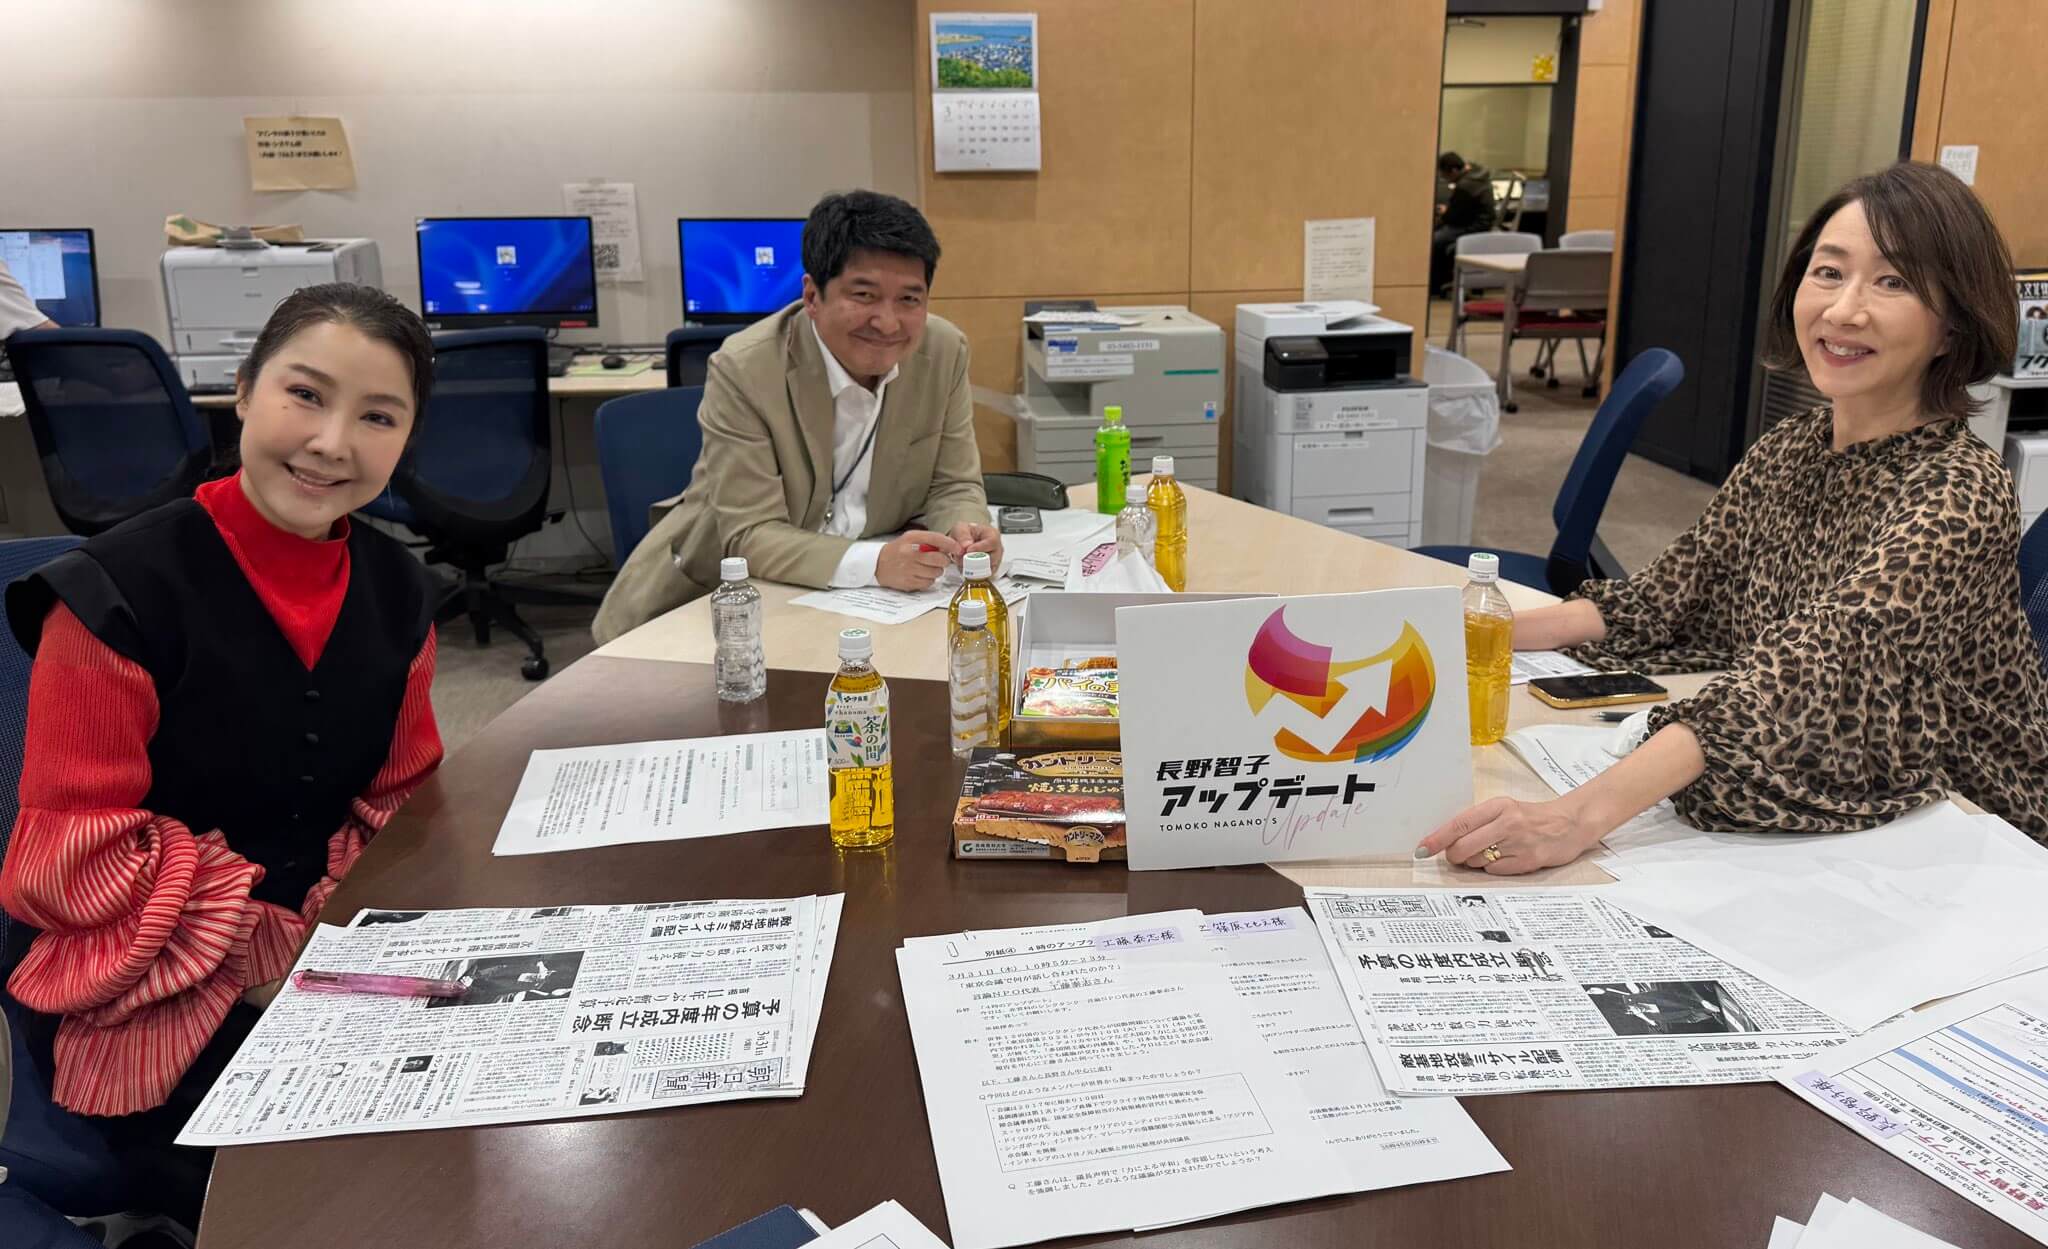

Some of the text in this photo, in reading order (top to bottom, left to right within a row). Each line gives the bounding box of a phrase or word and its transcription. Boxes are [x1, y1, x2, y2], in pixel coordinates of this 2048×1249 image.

[861, 715, 881, 762] 茶の間
[1156, 755, 1271, 781] 長野智子
[1160, 774, 1377, 816] アップデート
[1159, 821, 1209, 832] TOMOKO
[1262, 790, 1369, 850] Update
[1335, 899, 1426, 915] 朝日新聞
[651, 914, 794, 938] 敵基地攻撃ミサイル配備
[1100, 930, 1176, 948] 工藤泰志様
[1358, 952, 1512, 970] 予算の年度内成立
[572, 998, 782, 1033] 予算の年度内成立 断念
[1398, 1048, 1566, 1069] 敵基地攻撃ミサイル配備
[665, 1066, 774, 1091] 朝日新聞
[1811, 1077, 1898, 1132] 長野智子様
[1915, 1134, 2048, 1211] 長野智子アップデー
